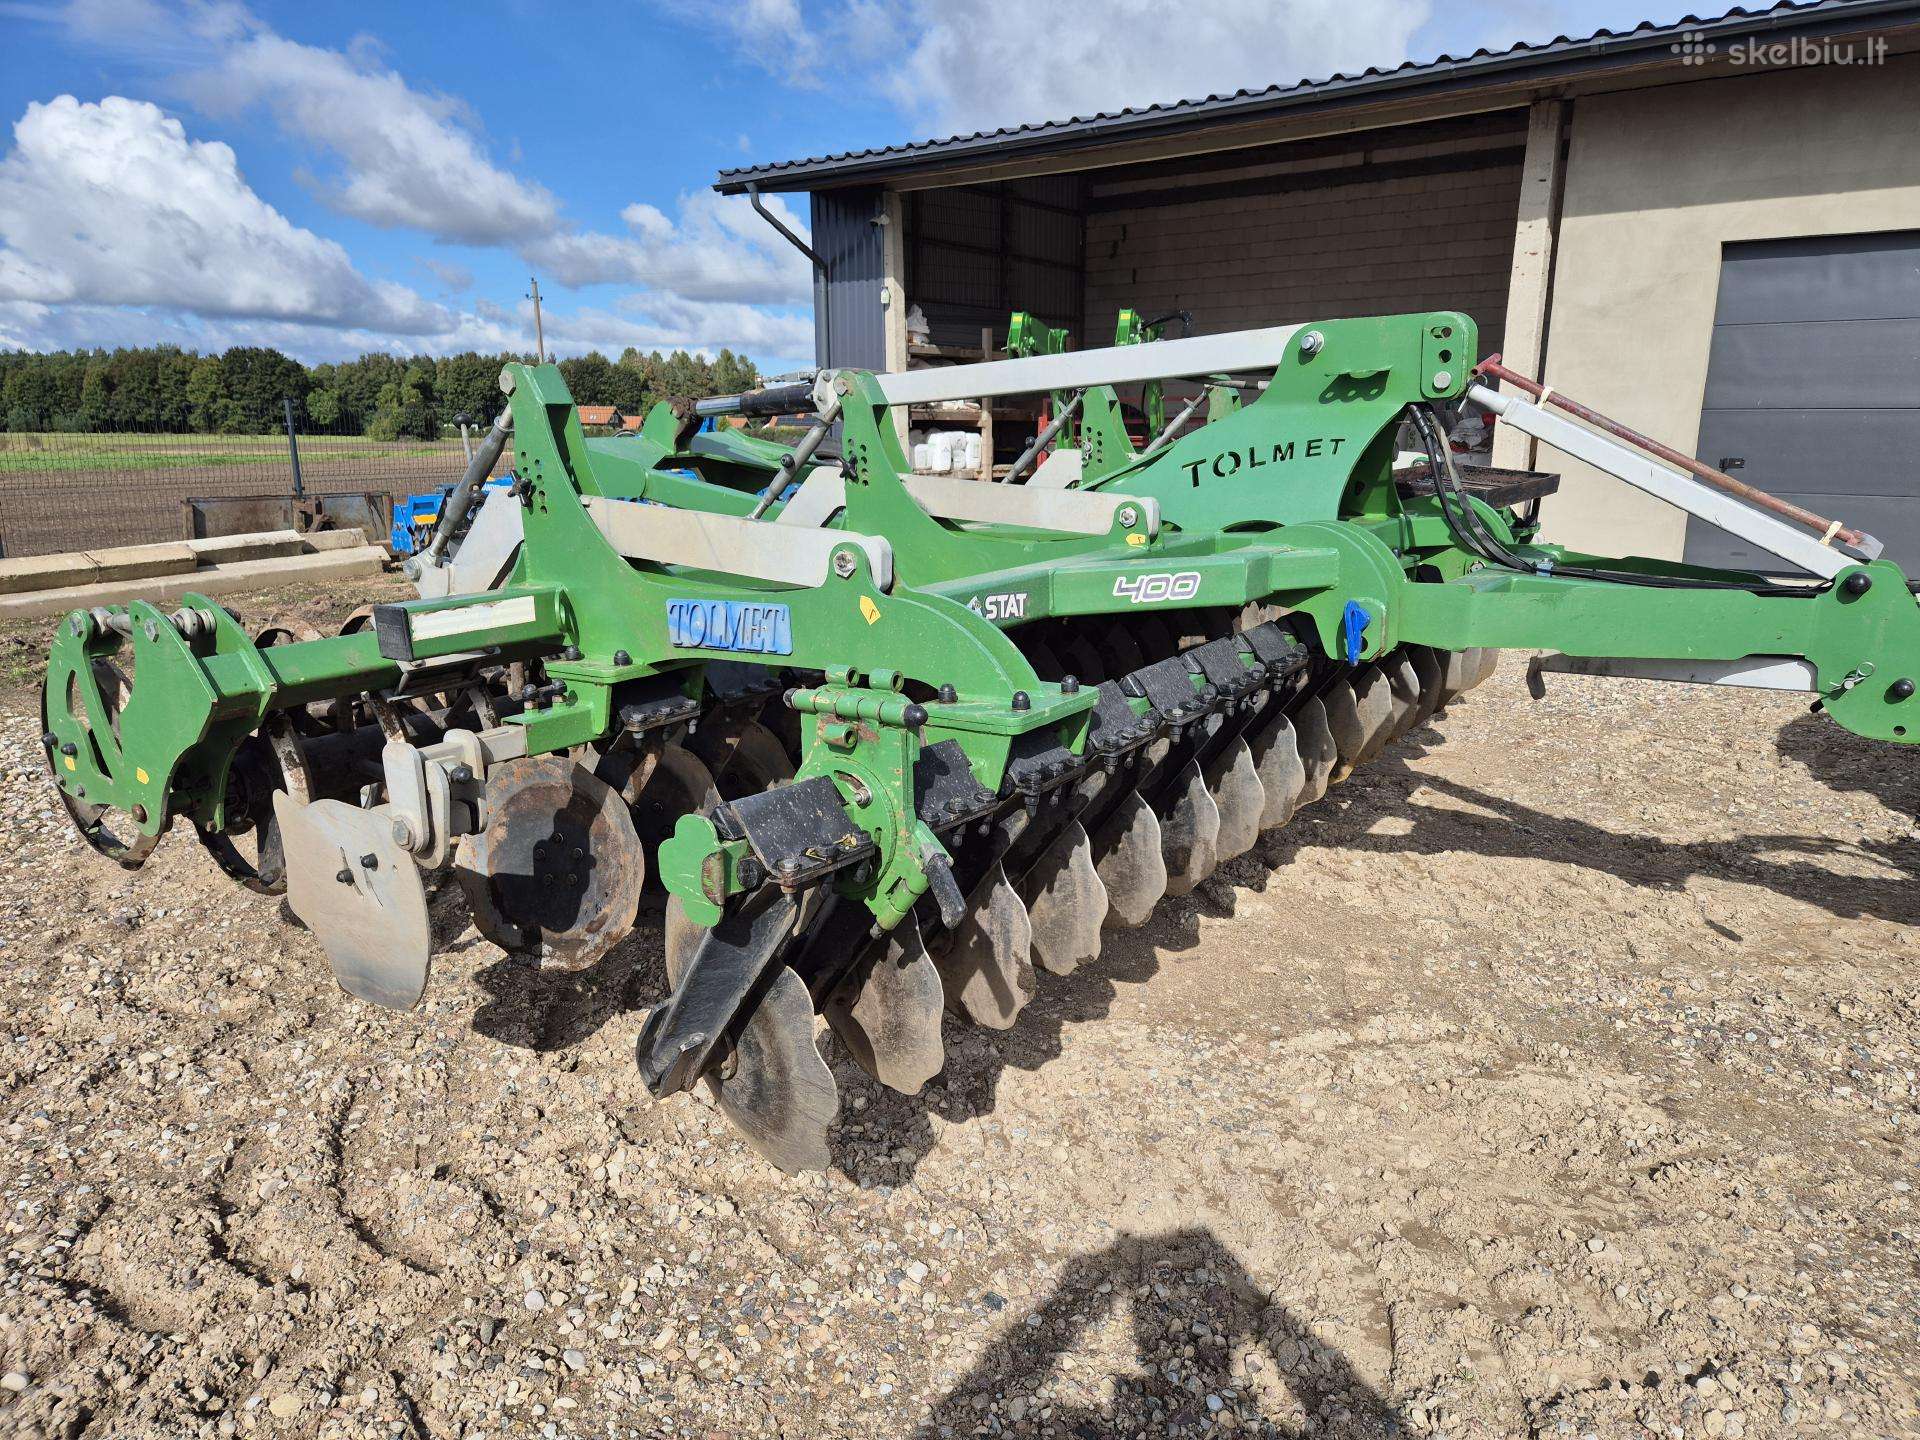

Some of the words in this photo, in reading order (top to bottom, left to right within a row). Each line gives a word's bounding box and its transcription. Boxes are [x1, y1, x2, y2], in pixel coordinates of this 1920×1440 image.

[1181, 438, 1346, 488] TOLMET
[984, 592, 1028, 620] STAT
[1112, 572, 1201, 604] 400
[669, 602, 786, 654] TOLMET
